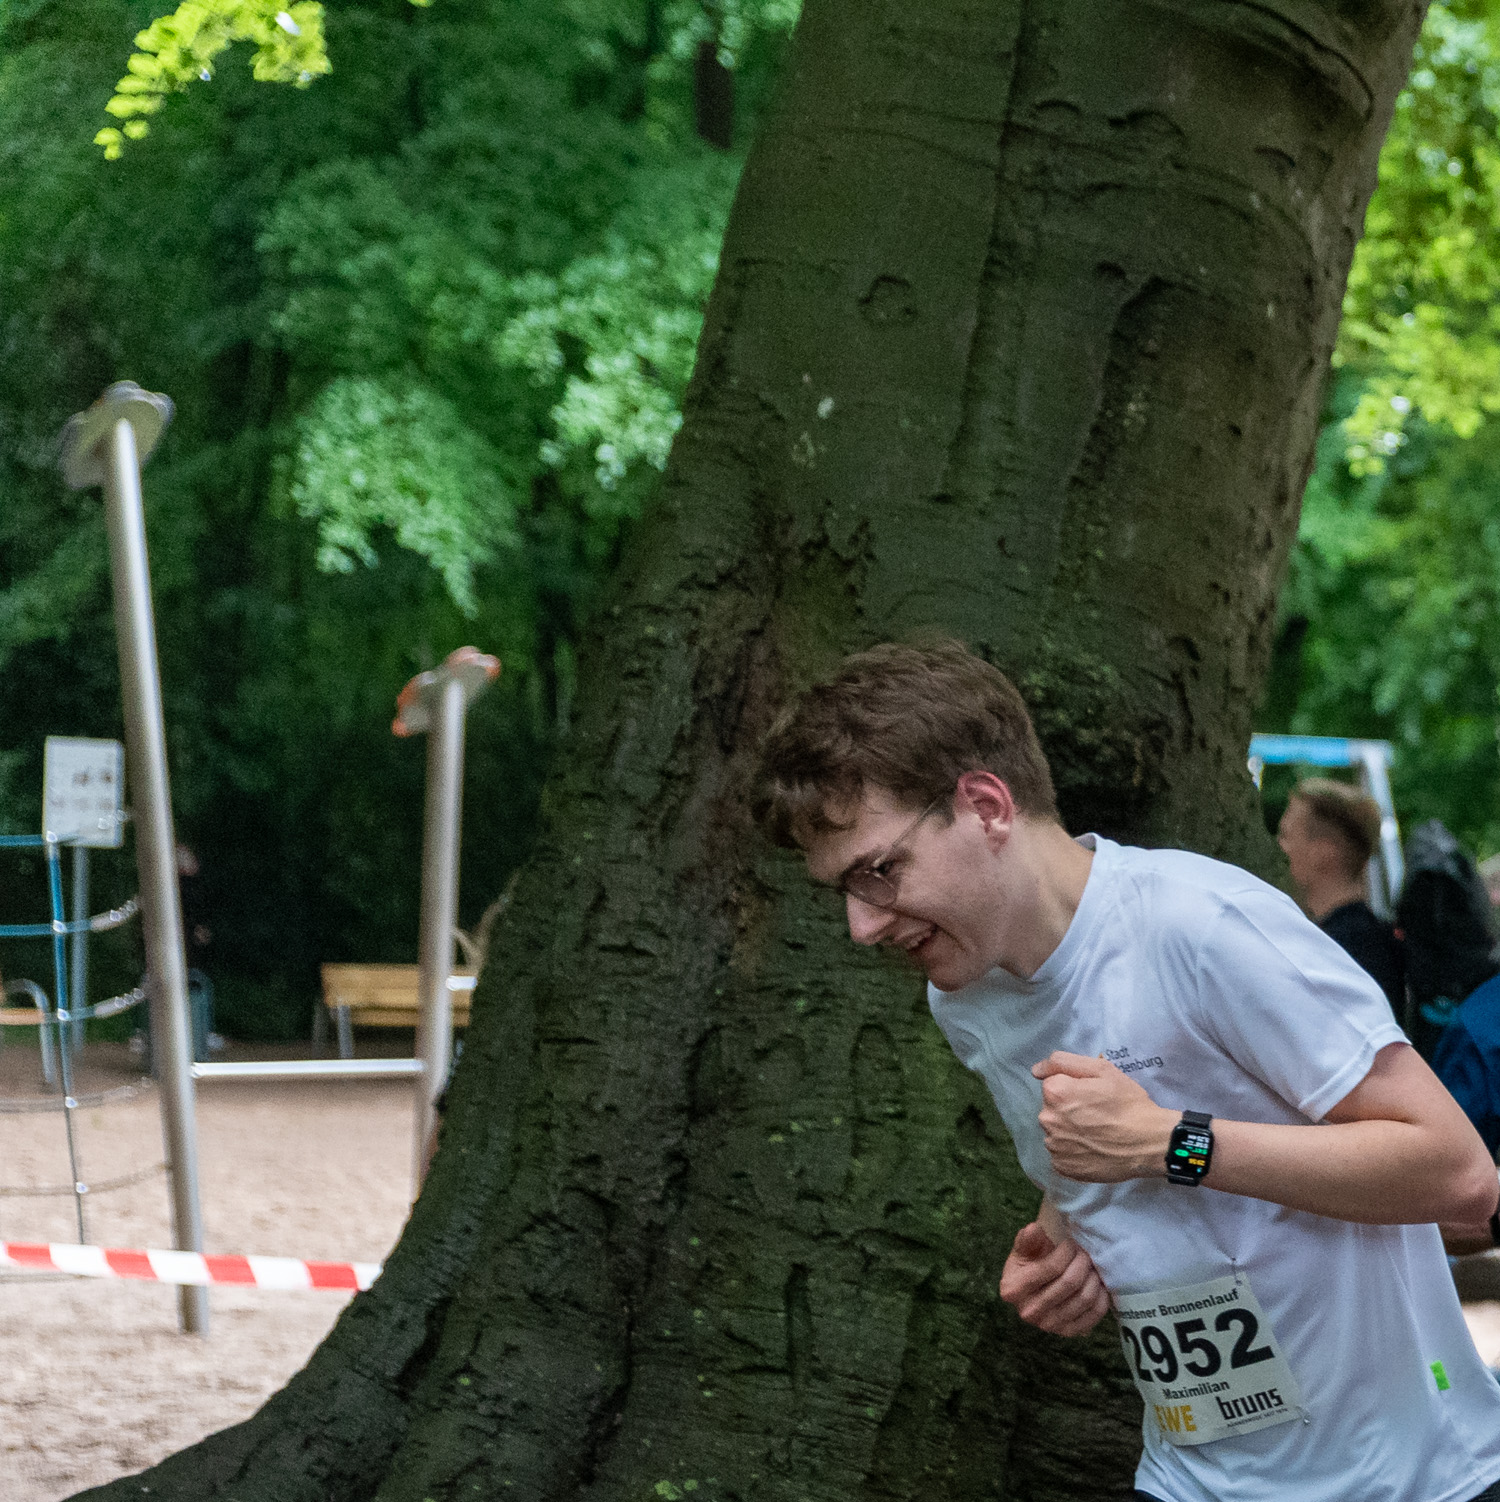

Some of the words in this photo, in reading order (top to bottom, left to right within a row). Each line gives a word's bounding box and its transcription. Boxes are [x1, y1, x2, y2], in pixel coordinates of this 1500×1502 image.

[1106, 1045, 1130, 1060] Stadt
[1114, 1056, 1164, 1073] denburg
[1158, 1288, 1240, 1316] Brunnenlauf
[1121, 1308, 1275, 1383] 2952
[1162, 1381, 1230, 1399] Maximilian
[1215, 1388, 1284, 1420] bruns
